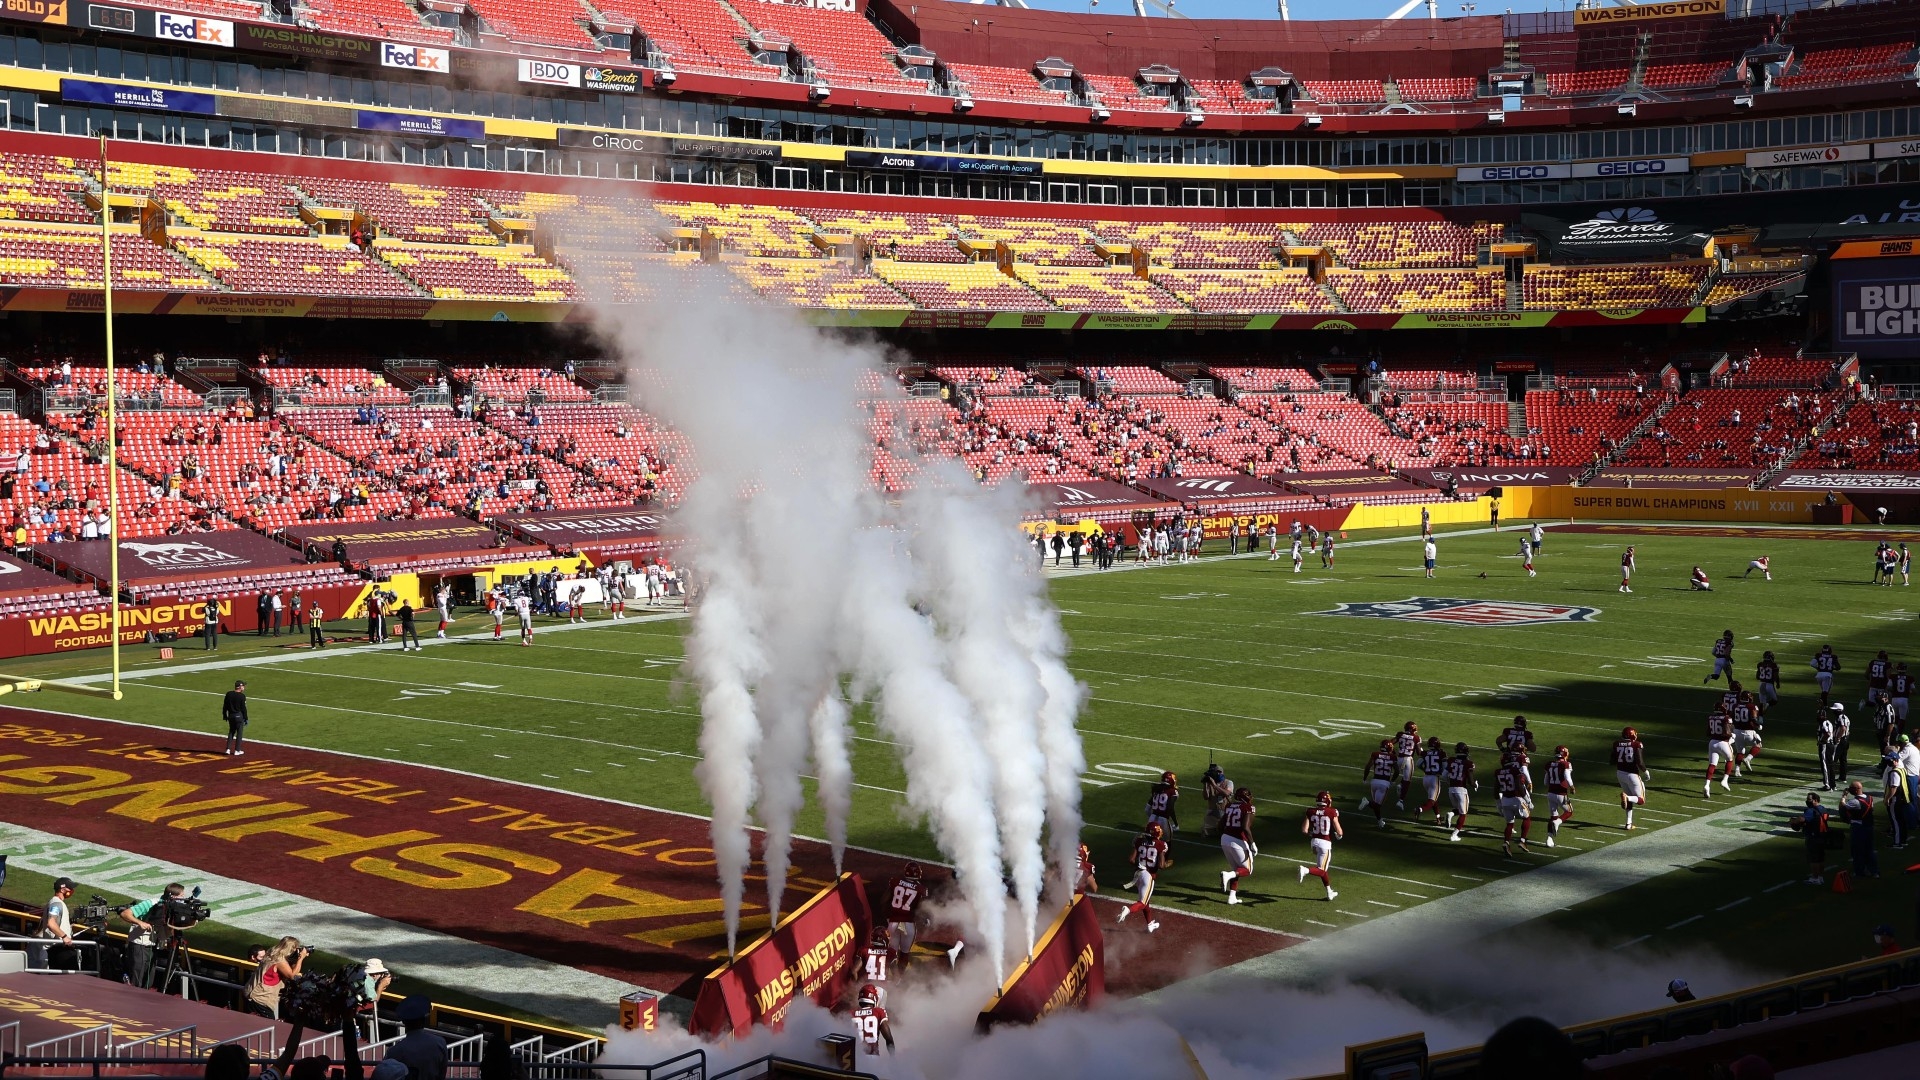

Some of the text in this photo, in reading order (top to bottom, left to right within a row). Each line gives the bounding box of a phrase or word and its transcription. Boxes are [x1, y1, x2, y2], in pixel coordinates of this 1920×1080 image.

[7, 0, 45, 14] GOLD
[1580, 1, 1720, 21] WASHINGTON
[160, 15, 222, 43] FedEx
[248, 27, 371, 51] WASHINGTON
[384, 44, 440, 69] FedEx
[534, 62, 569, 79] BDO
[601, 68, 638, 84] Sports
[587, 80, 635, 92] WASHINGTON
[114, 92, 151, 102] MERRILL
[400, 120, 431, 129] MERRILL
[592, 133, 644, 151] CÎROC
[881, 156, 915, 167] Acronis
[1773, 149, 1824, 164] SAFEWAY
[958, 161, 970, 169] Get
[1011, 165, 1033, 173] Acronis
[1482, 165, 1549, 179] GEICO
[1597, 160, 1666, 176] GEICO
[1561, 232, 1674, 240] WASHINGTON
[1568, 219, 1670, 237] Sports
[1880, 241, 1913, 253] GIANTS
[195, 296, 296, 307] WASHINGTON
[1097, 315, 1160, 323] WASHINGTON
[1426, 313, 1522, 322] WASHINGTON
[1460, 471, 1549, 482] INOVA
[1574, 497, 1612, 508] SUPER
[1615, 498, 1650, 509] BOWL
[1653, 498, 1726, 511] CHAMPIONS
[1734, 500, 1760, 512] XVII
[1769, 501, 1795, 513] XXII
[507, 517, 541, 525] THE
[306, 526, 493, 542] WASHINGTON
[138, 550, 241, 565] MGM
[1375, 758, 1392, 776] 25
[1425, 756, 1440, 773] 15
[1450, 762, 1464, 781] 31
[1498, 773, 1515, 792] 53
[1226, 807, 1242, 827] 72
[1310, 815, 1331, 836] 30
[1138, 846, 1158, 868] 29
[891, 885, 918, 911] 87
[754, 917, 855, 1016] WASHINGTON
[865, 954, 887, 981] 41
